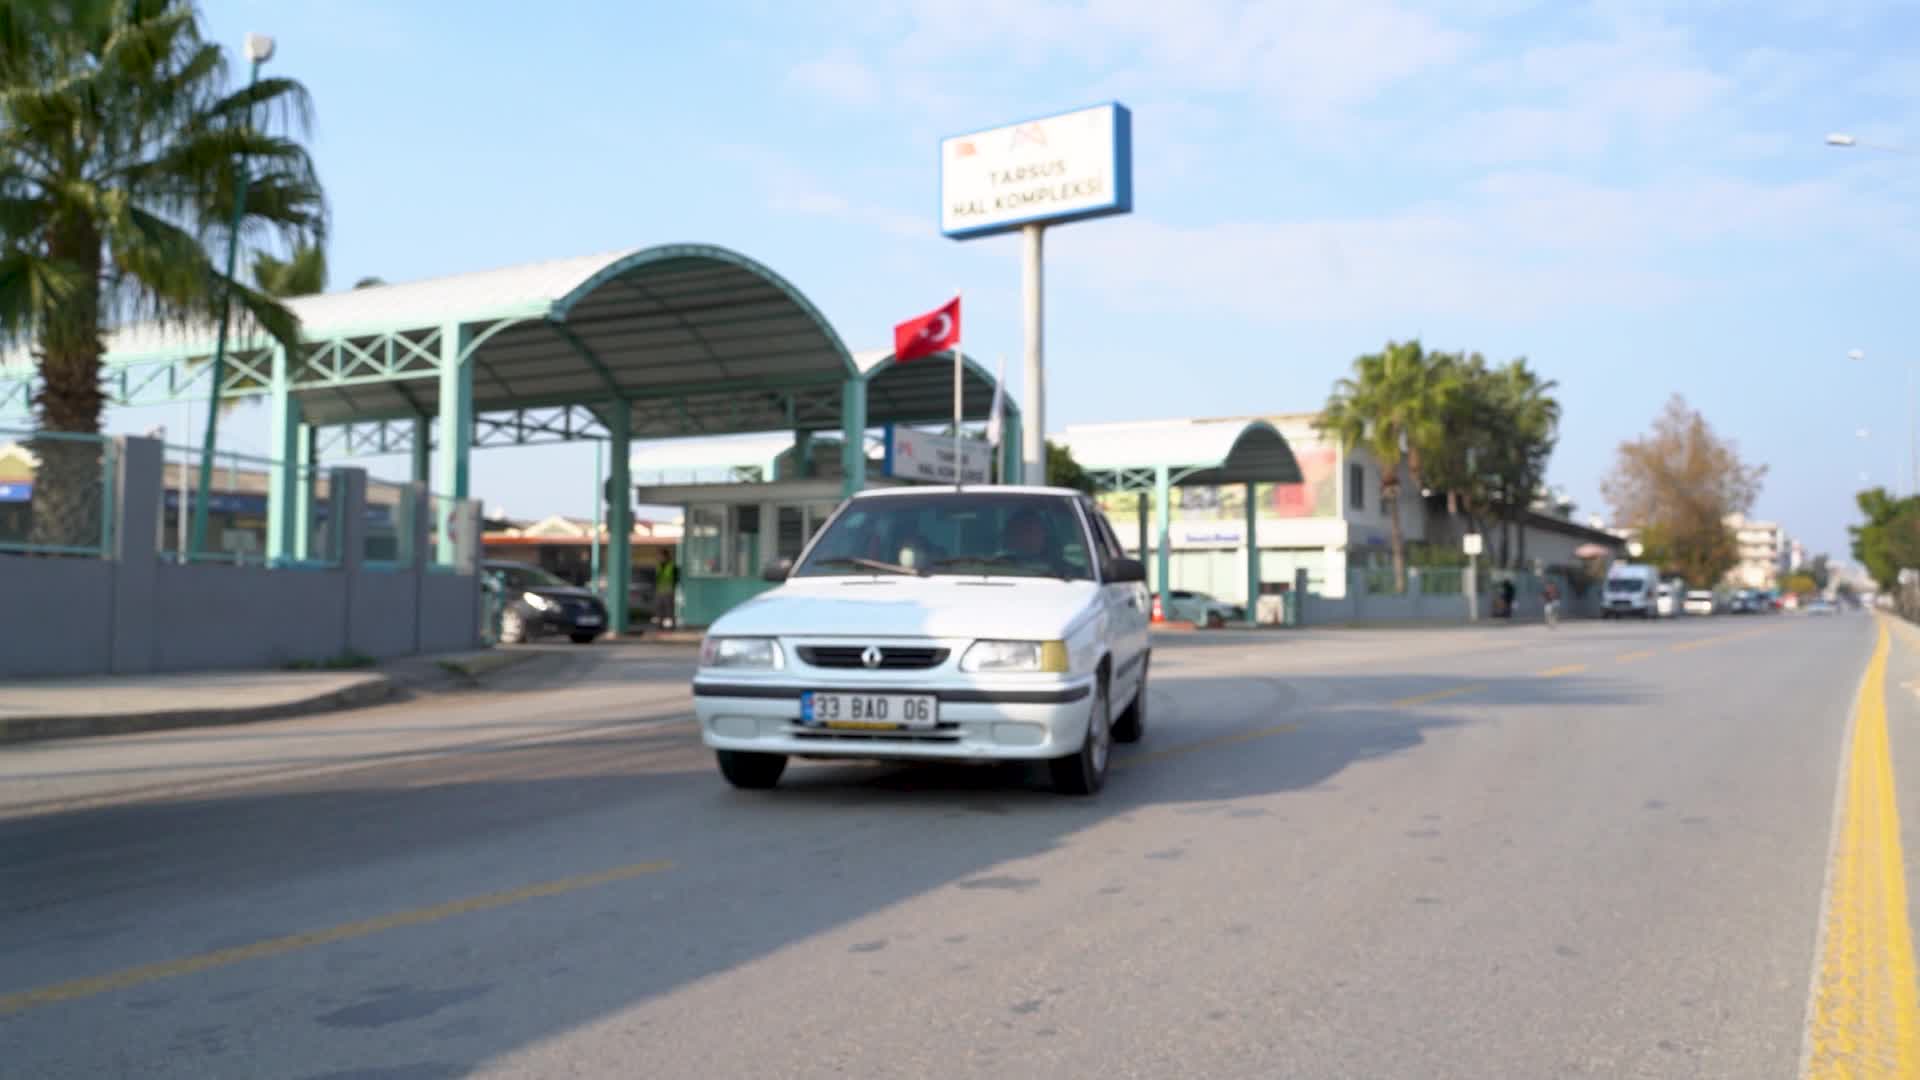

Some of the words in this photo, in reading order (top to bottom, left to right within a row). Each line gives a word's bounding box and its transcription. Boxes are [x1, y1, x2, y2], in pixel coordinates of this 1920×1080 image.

[989, 159, 1067, 185] TARSUS
[952, 200, 987, 217] HAL
[816, 695, 839, 718] 33
[903, 698, 929, 720] 06
